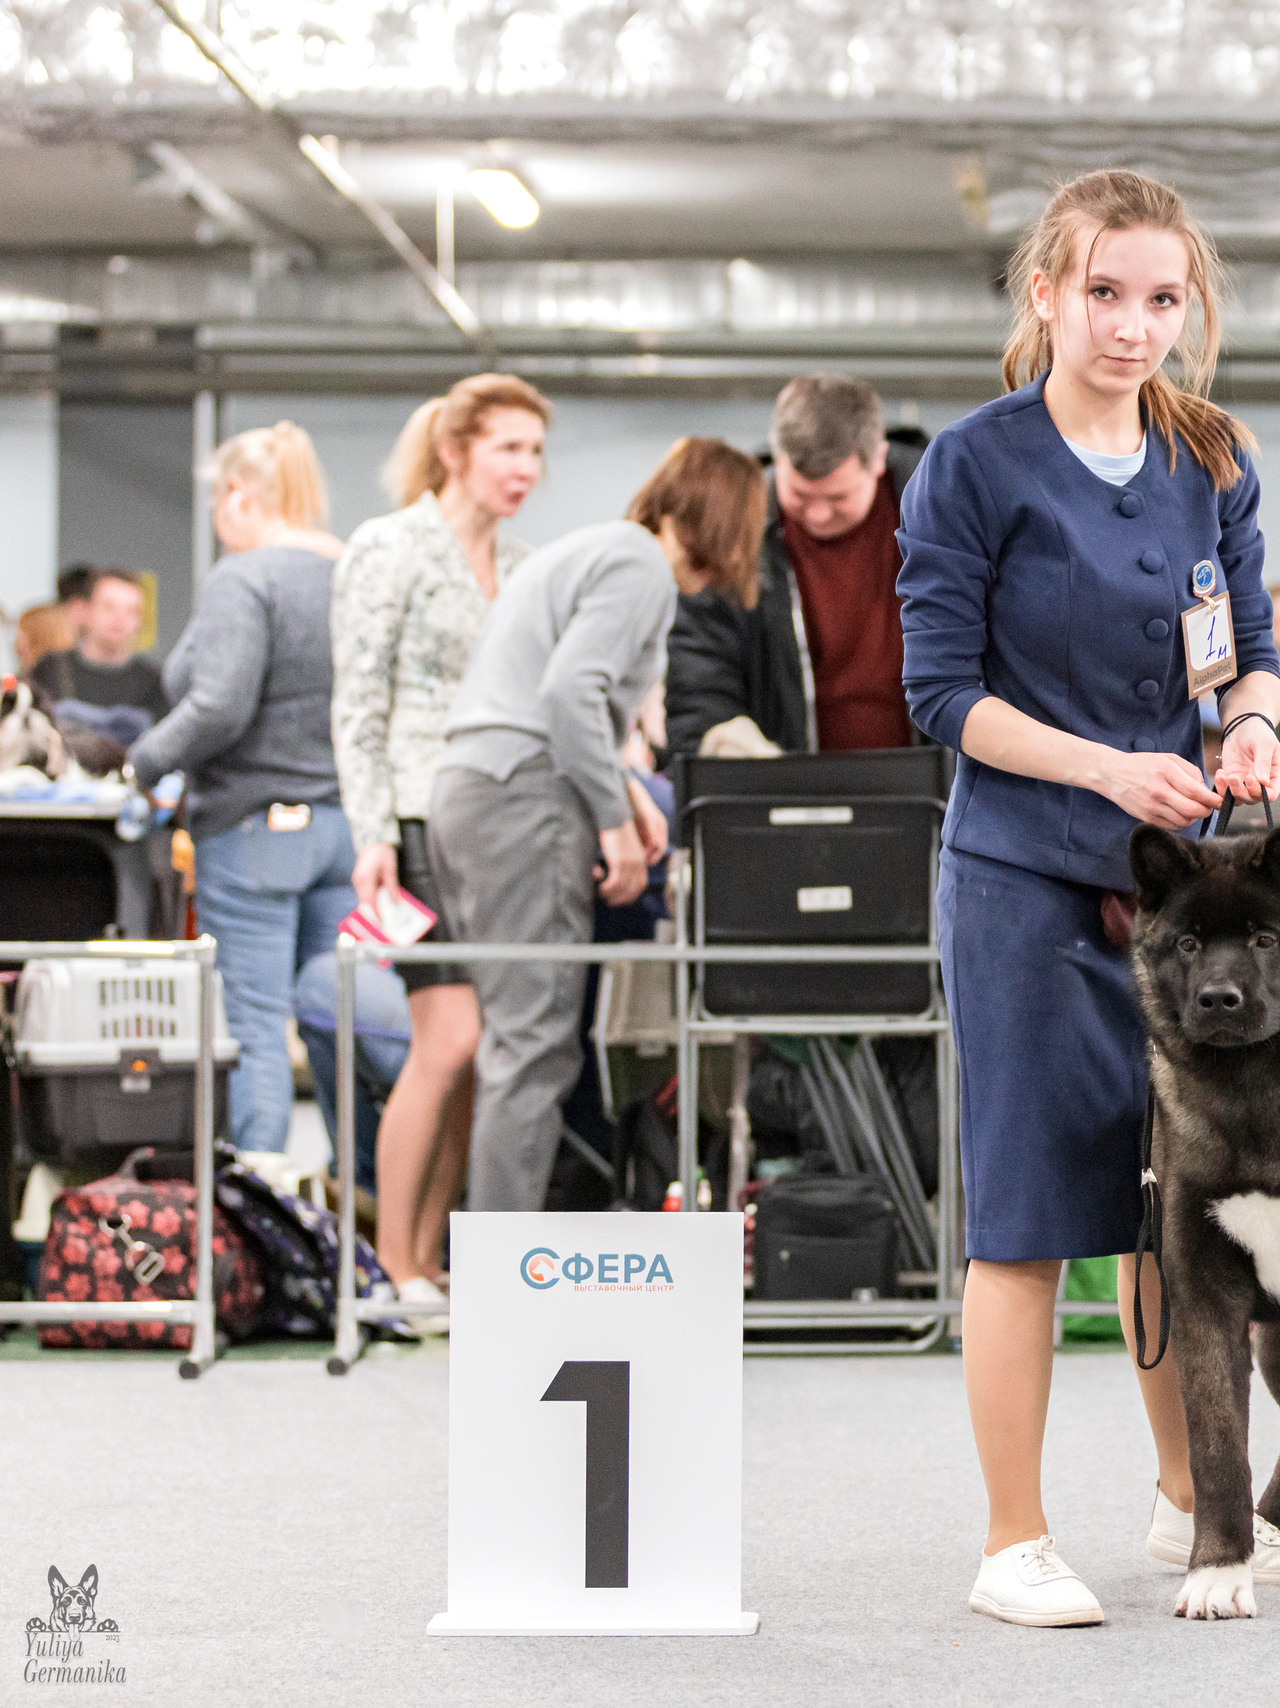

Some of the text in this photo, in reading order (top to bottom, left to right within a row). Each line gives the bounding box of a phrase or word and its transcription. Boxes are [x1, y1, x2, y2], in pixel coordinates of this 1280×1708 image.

[1193, 662, 1232, 687] AlphaPet
[520, 1247, 674, 1290] СФЕРА
[574, 1284, 674, 1293] ВЫСТАВОЧНЫЙ ЦЕНТР
[539, 1361, 630, 1588] 1
